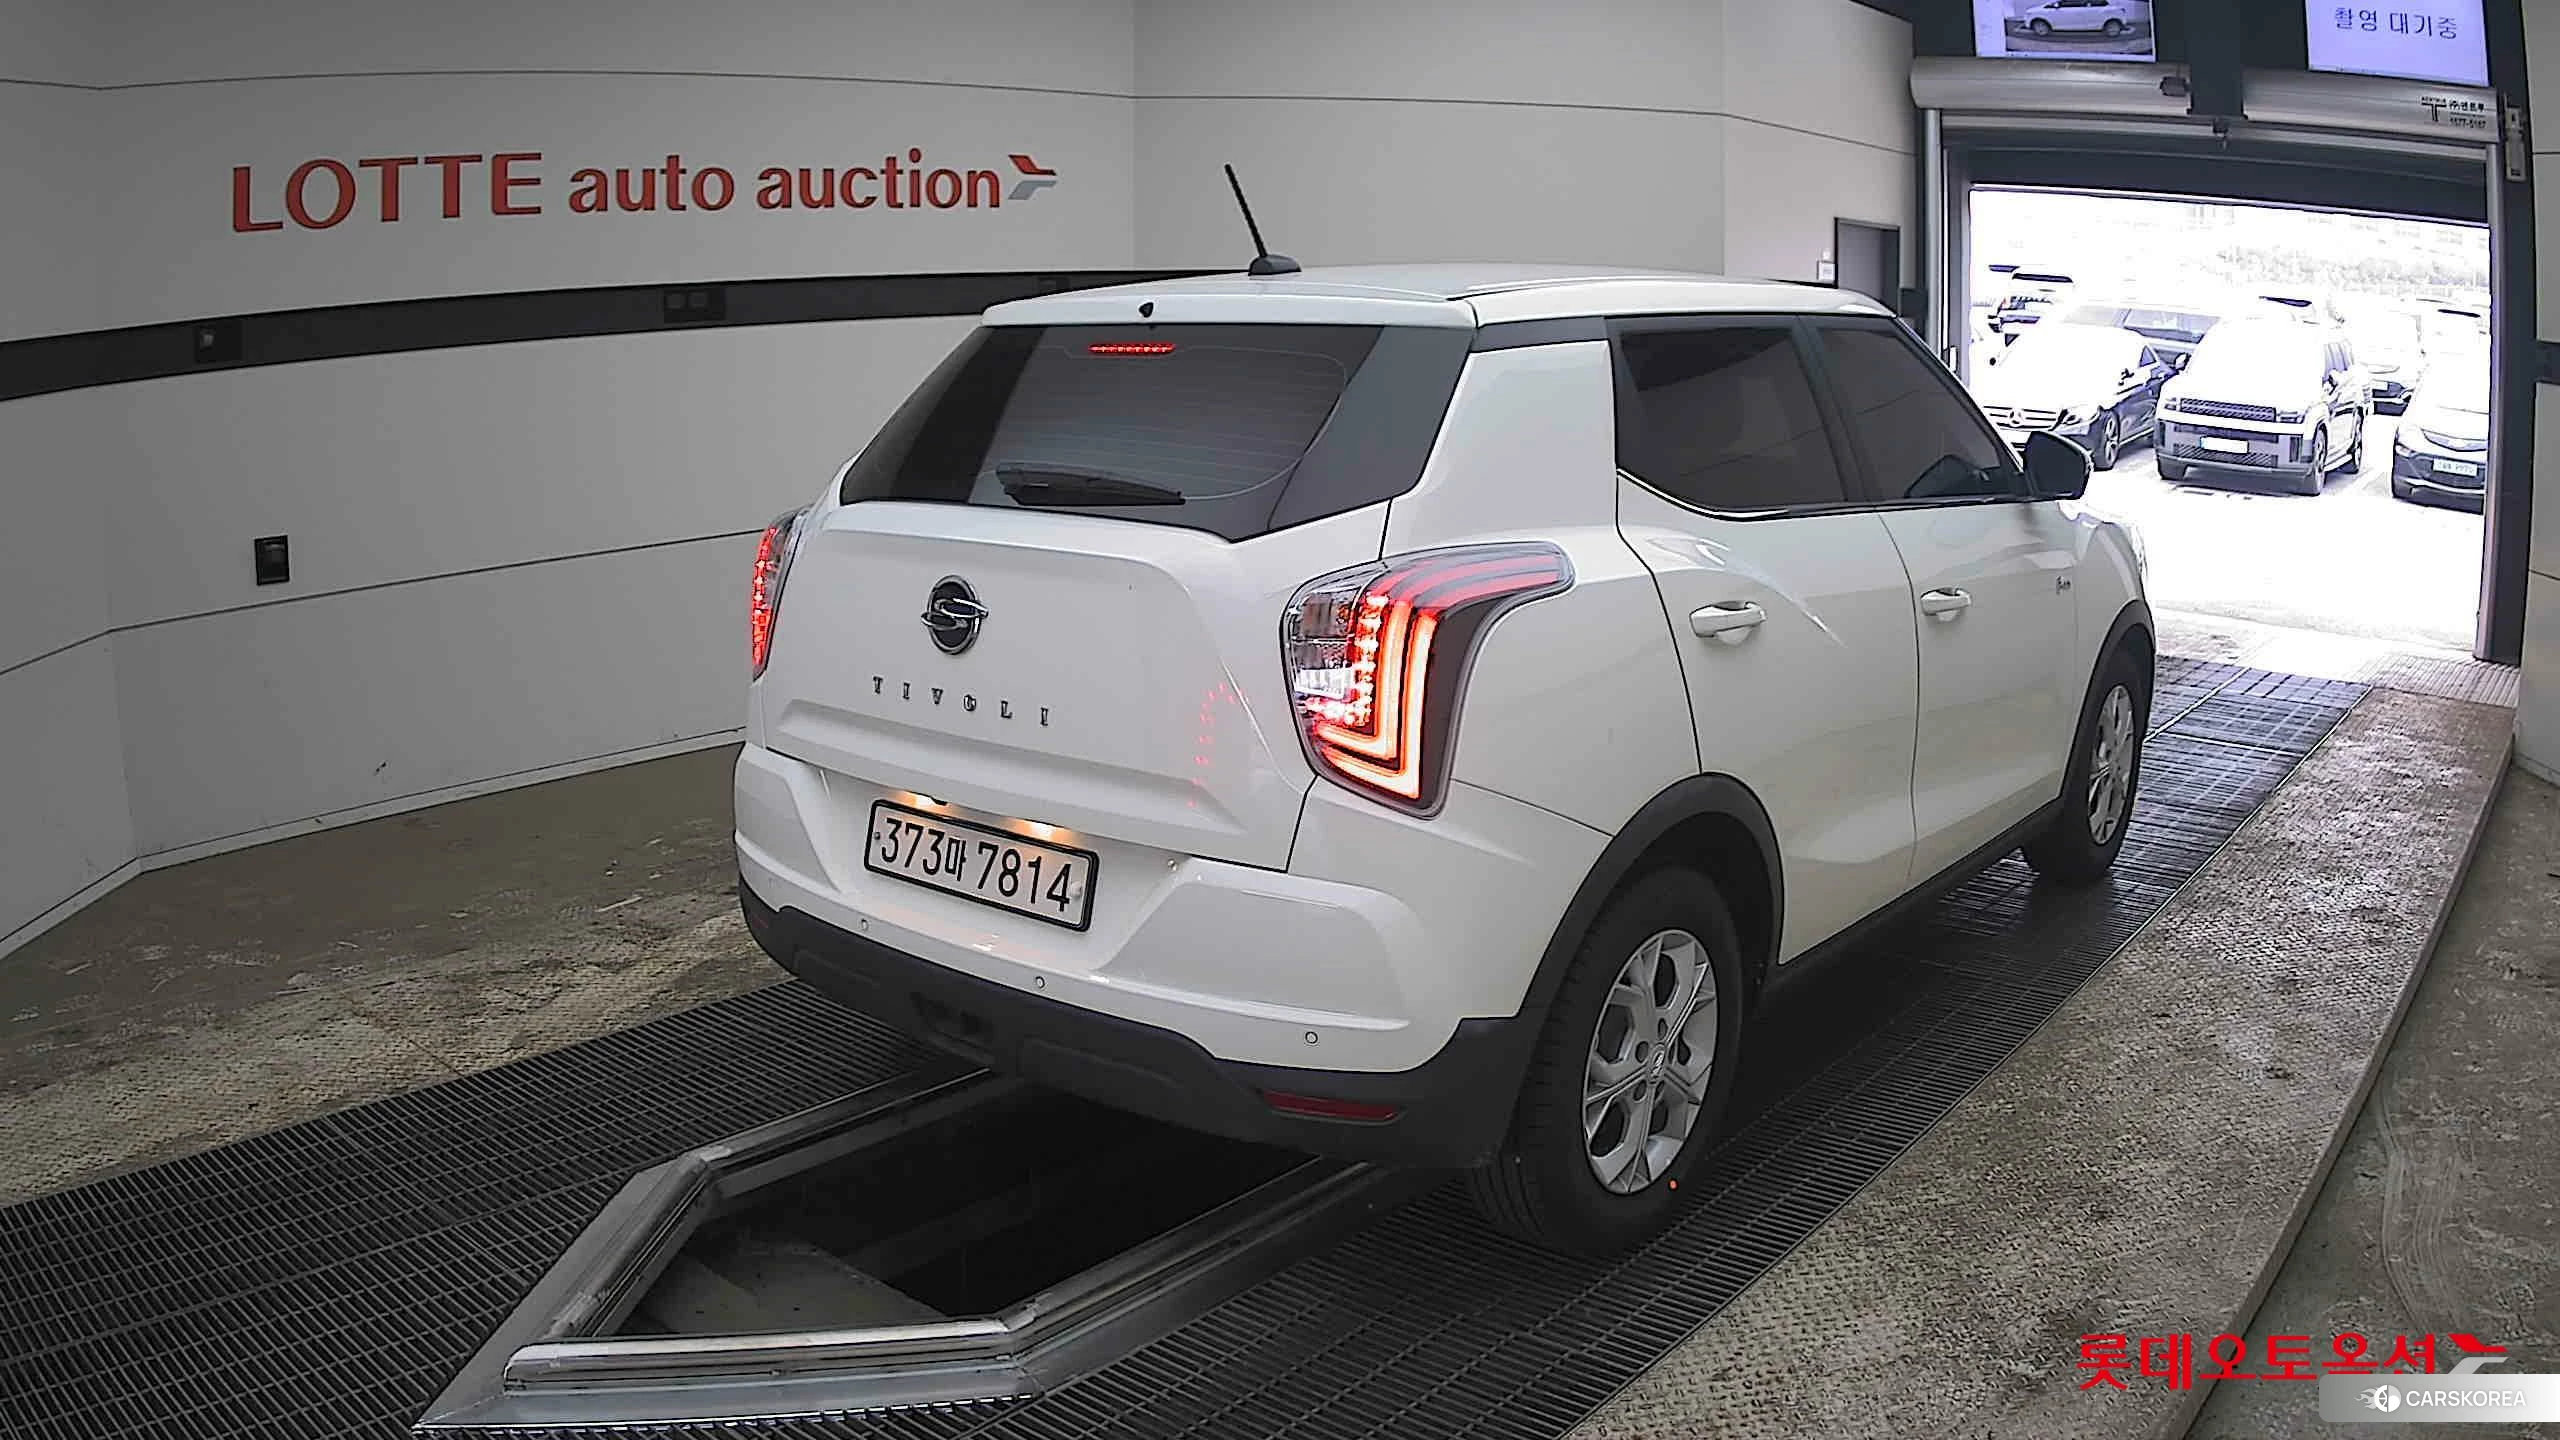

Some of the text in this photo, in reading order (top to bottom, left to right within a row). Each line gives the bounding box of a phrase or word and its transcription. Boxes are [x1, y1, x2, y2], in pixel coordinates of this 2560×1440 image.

[2335, 8, 2457, 39] 촬영 대기중
[232, 147, 1001, 233] LOTTE auto auction
[872, 676, 1050, 727] TIVOLI
[880, 817, 1072, 913] 373마 7814
